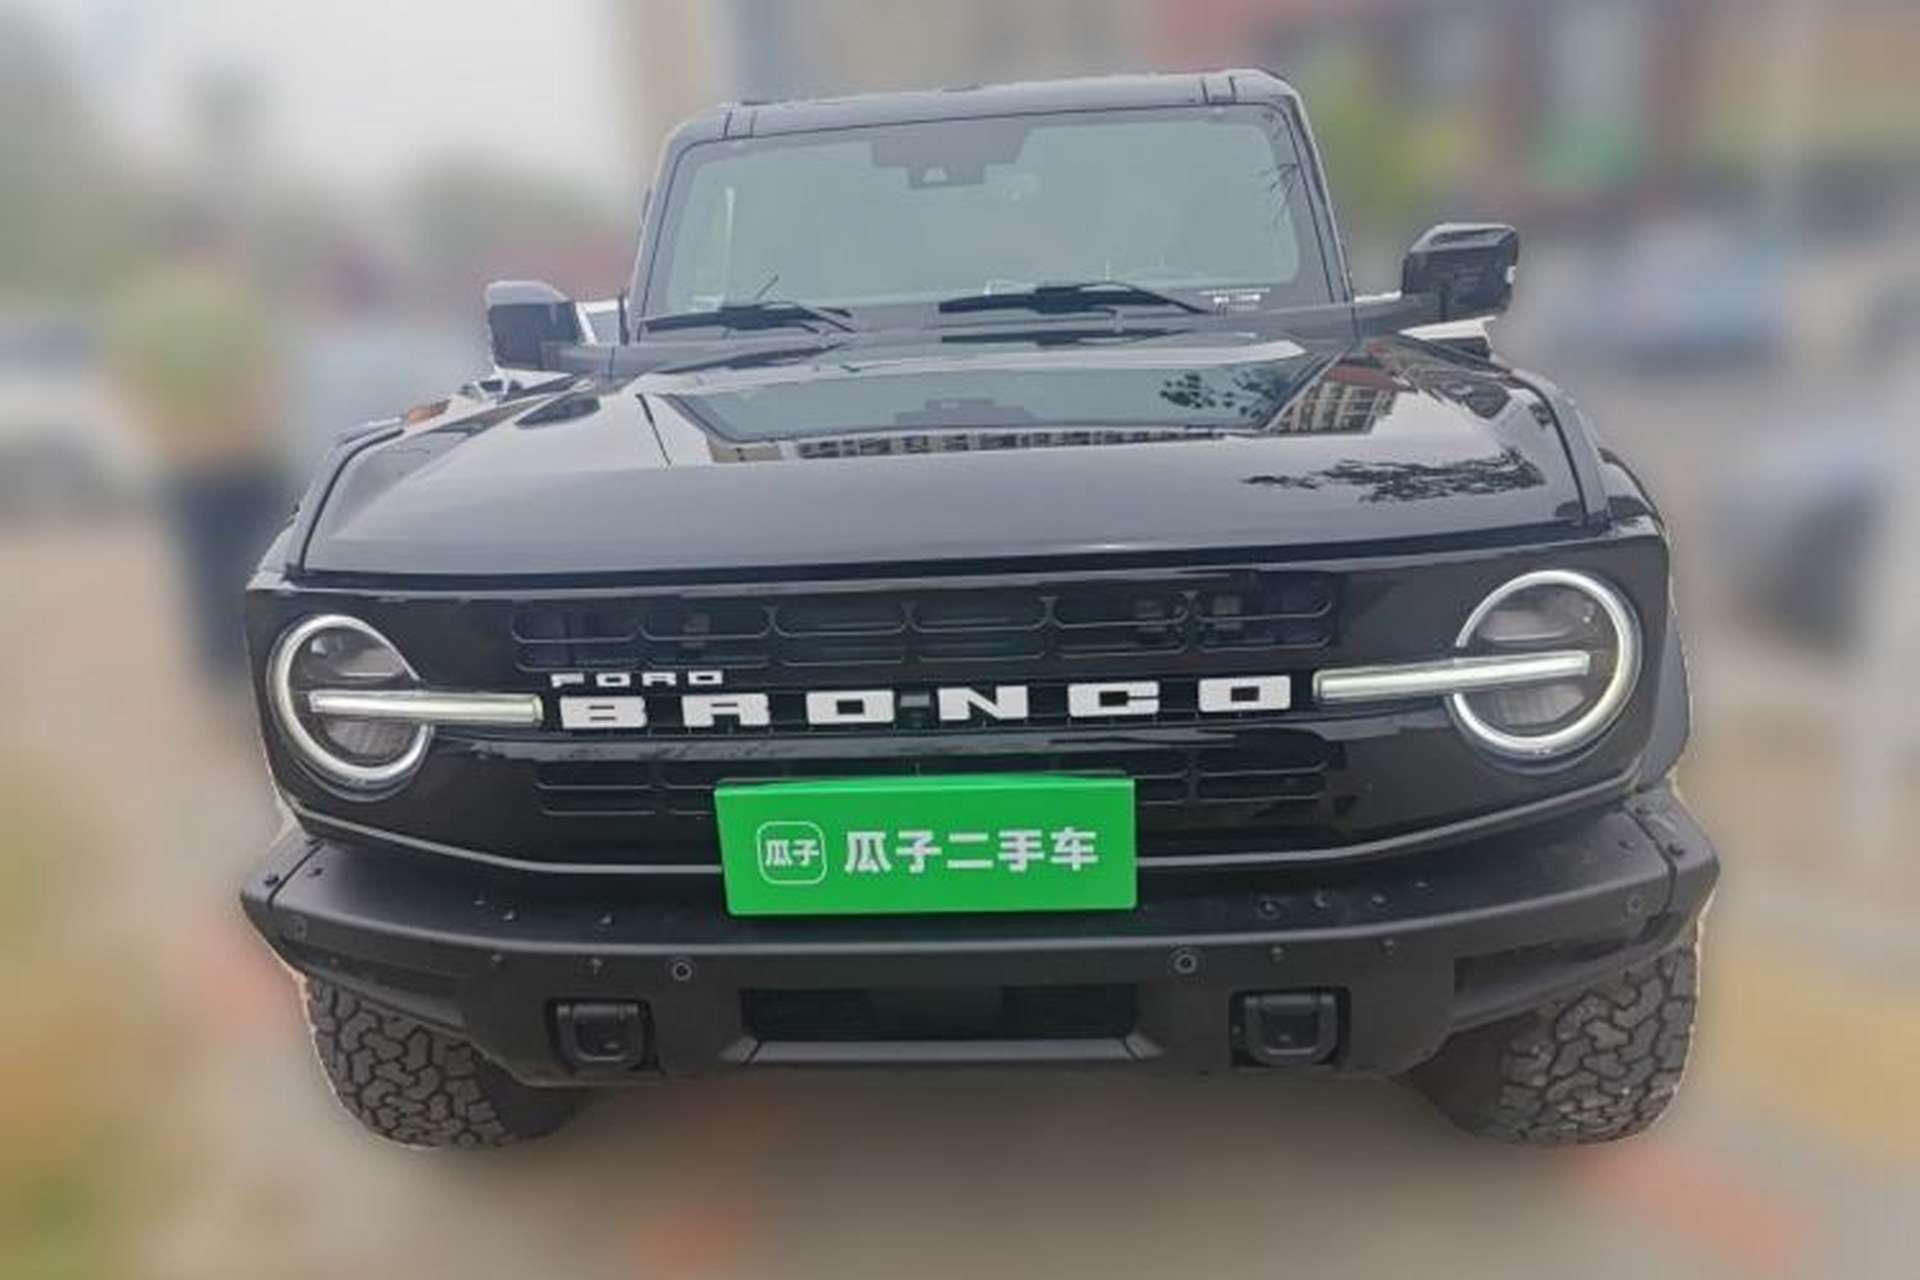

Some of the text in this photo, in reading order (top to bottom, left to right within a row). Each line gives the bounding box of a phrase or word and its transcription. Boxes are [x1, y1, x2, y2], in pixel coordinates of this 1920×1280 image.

[551, 670, 724, 688] FORD
[560, 675, 1292, 729] BRONCO
[765, 839, 820, 867] 瓜子
[844, 827, 1099, 873] 瓜子二手车
